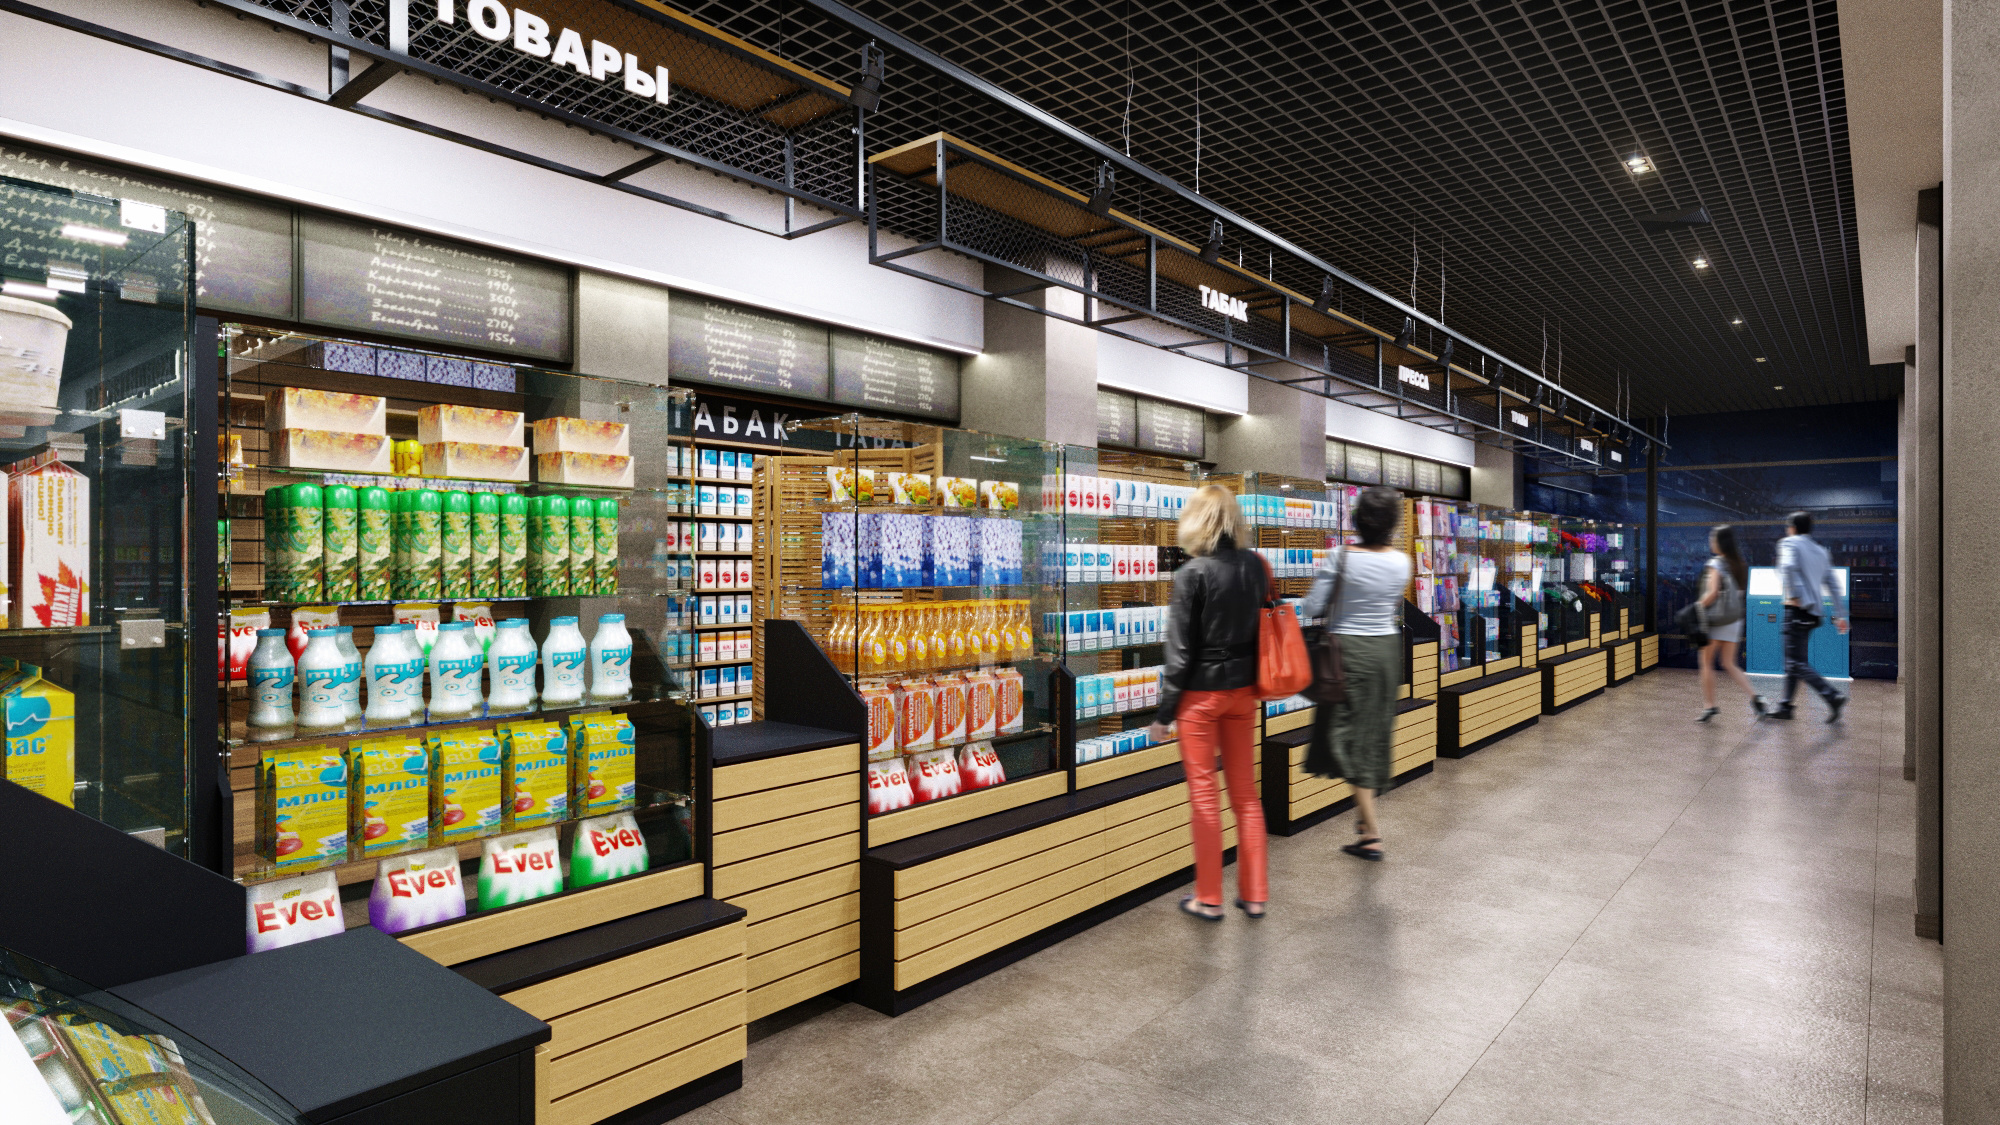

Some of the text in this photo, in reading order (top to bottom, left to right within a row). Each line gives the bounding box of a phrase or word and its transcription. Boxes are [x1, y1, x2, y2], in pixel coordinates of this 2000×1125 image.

[371, 229, 407, 247] Товар
[1198, 284, 1249, 323] ТАБАК
[1398, 364, 1430, 391] ПРЕССА
[669, 398, 790, 441] ТАБАК
[38, 476, 46, 521] кцию!
[47, 476, 55, 536] сенною
[57, 476, 65, 546] бъявляет
[868, 770, 907, 789] Ever
[919, 759, 957, 778] Ever
[590, 828, 643, 857] Ever
[491, 849, 554, 874] Ever
[282, 888, 301, 900] NEW
[387, 866, 458, 898] Ever
[254, 894, 336, 934] Ever
